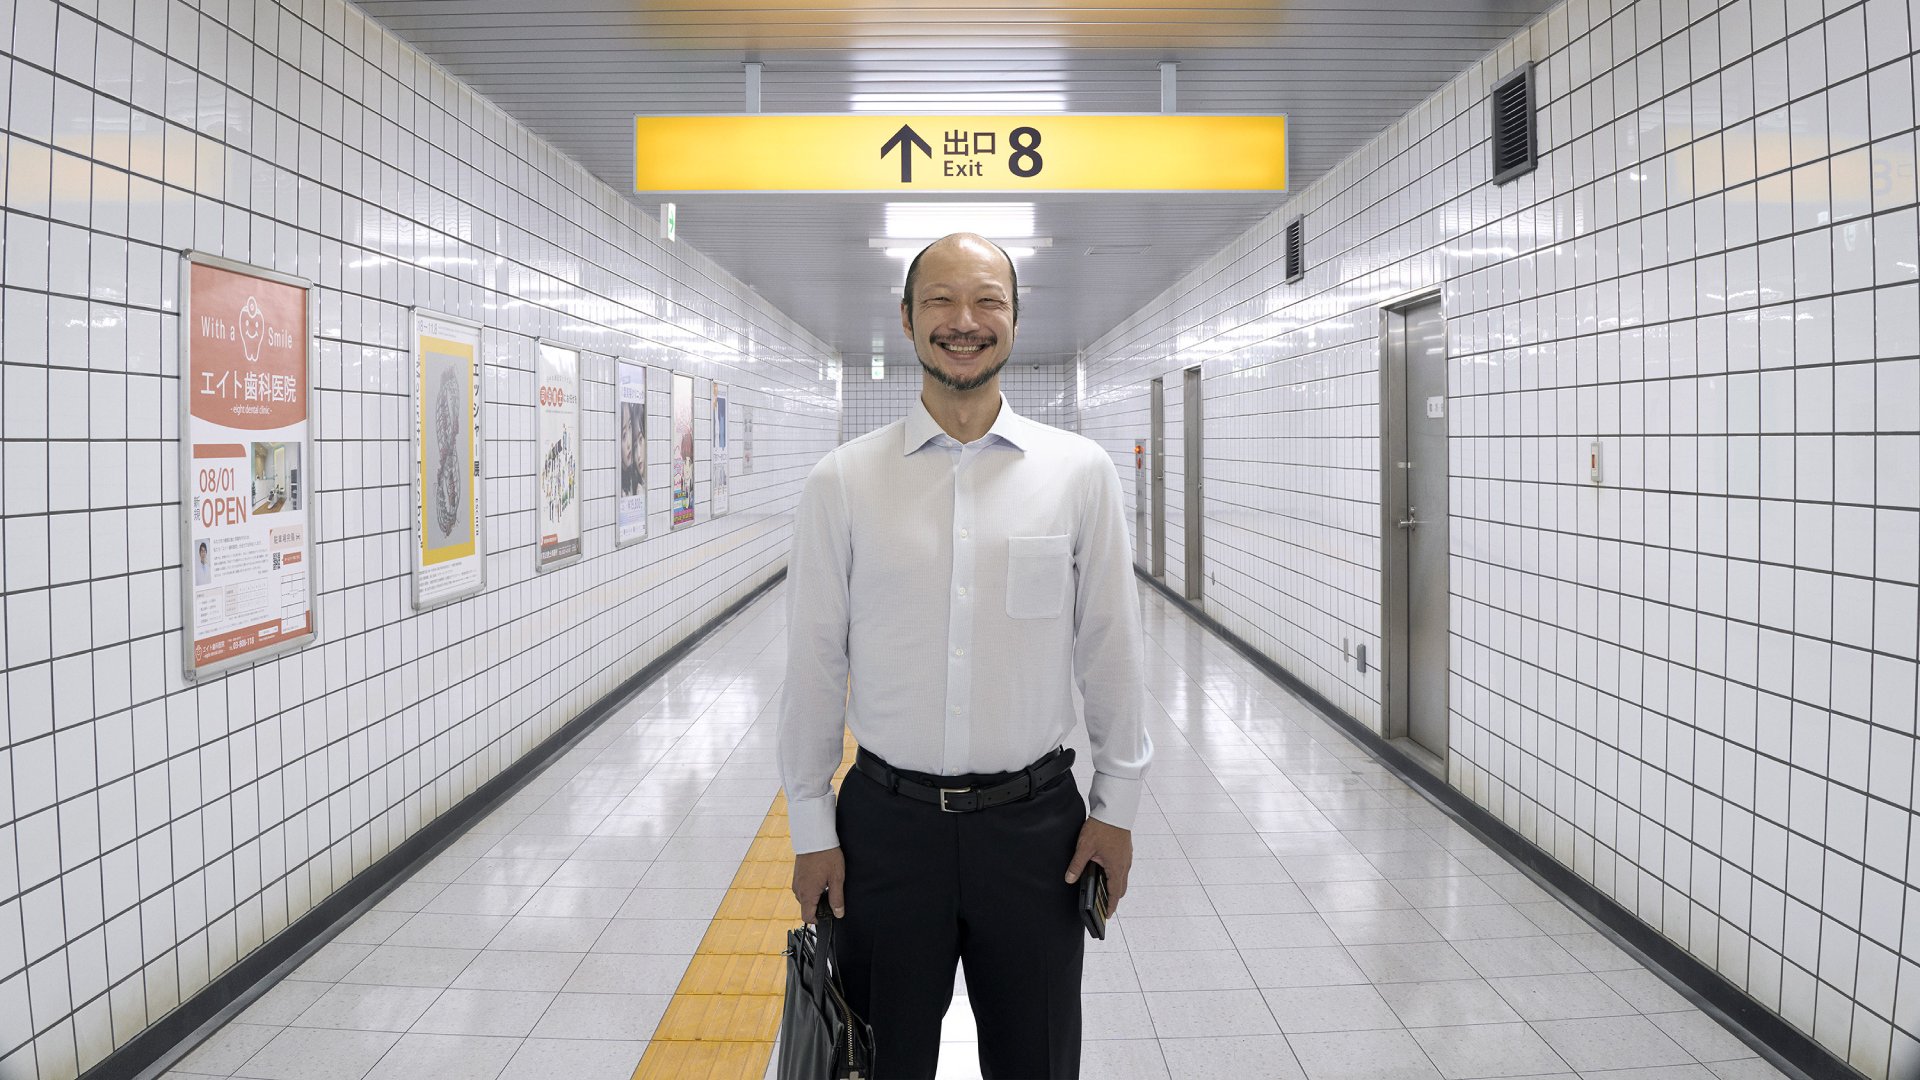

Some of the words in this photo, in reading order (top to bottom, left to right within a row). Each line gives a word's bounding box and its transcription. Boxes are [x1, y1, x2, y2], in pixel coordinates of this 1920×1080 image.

[943, 129, 996, 156] 出口
[1008, 126, 1043, 178] 8
[943, 159, 983, 177] Exit
[201, 315, 225, 340] With
[230, 325, 236, 341] a
[268, 327, 293, 349] Smile
[200, 370, 297, 403] エイト歯科医院
[245, 404, 259, 414] dental
[199, 467, 235, 493] 08/01
[202, 496, 247, 528] OPEN
